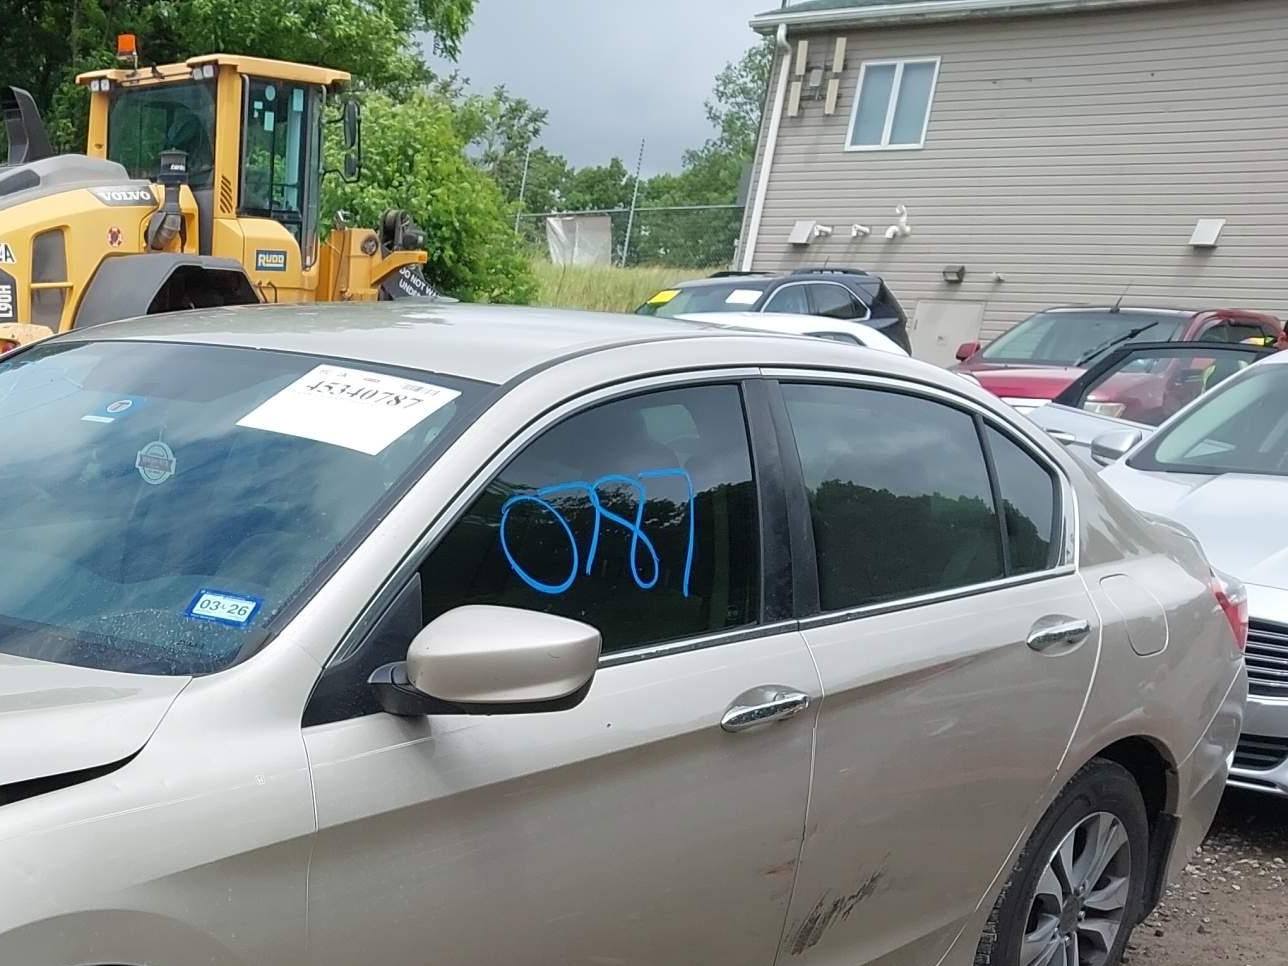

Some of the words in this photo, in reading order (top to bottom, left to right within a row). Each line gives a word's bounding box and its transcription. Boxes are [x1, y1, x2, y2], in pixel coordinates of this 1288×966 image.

[102, 190, 150, 200] VOLVO
[258, 253, 285, 267] RUDD
[410, 274, 426, 290] NOT
[306, 380, 424, 409] 45340787
[500, 467, 695, 598] 0787
